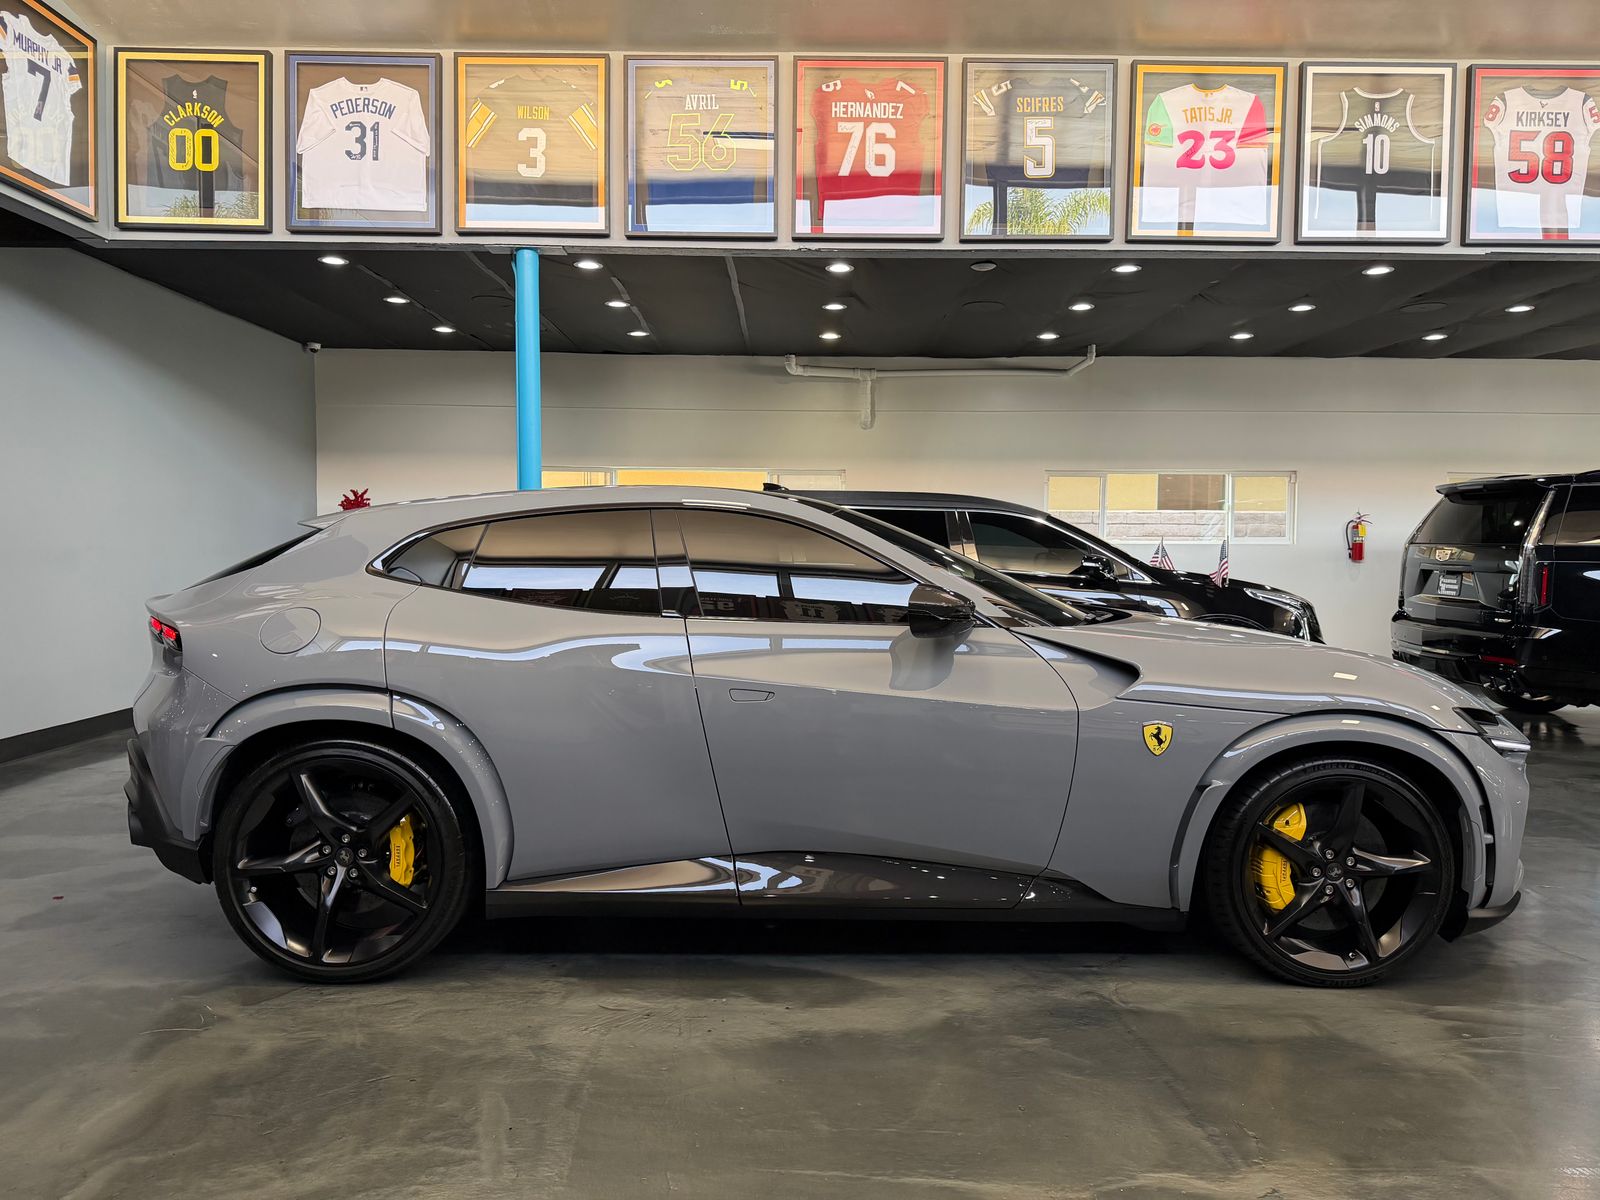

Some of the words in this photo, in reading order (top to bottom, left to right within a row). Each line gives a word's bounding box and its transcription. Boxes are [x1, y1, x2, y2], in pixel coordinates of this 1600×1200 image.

[12, 29, 50, 66] MURPHY
[52, 57, 63, 75] JR
[27, 58, 51, 122] 7
[685, 94, 719, 110] AVRIL
[895, 80, 916, 95] 7
[163, 102, 225, 128] CLARKSON
[330, 97, 396, 120] PEDERSON
[517, 105, 550, 120] WILSON
[831, 101, 904, 119] HERNANDEZ
[1016, 96, 1064, 113] SCIFRES
[1182, 106, 1215, 124] TATIS
[1484, 104, 1500, 122] 8
[1516, 111, 1570, 127] KIRKSEY
[1354, 113, 1400, 133] SIMMONS
[168, 127, 220, 172] 00
[345, 121, 379, 161] 31
[517, 127, 547, 178] 3
[667, 113, 736, 171] 56
[837, 121, 896, 177] 76
[1023, 116, 1056, 179] 5
[1176, 130, 1236, 170] 23
[1362, 133, 1391, 175] 10
[1507, 130, 1575, 185] 58
